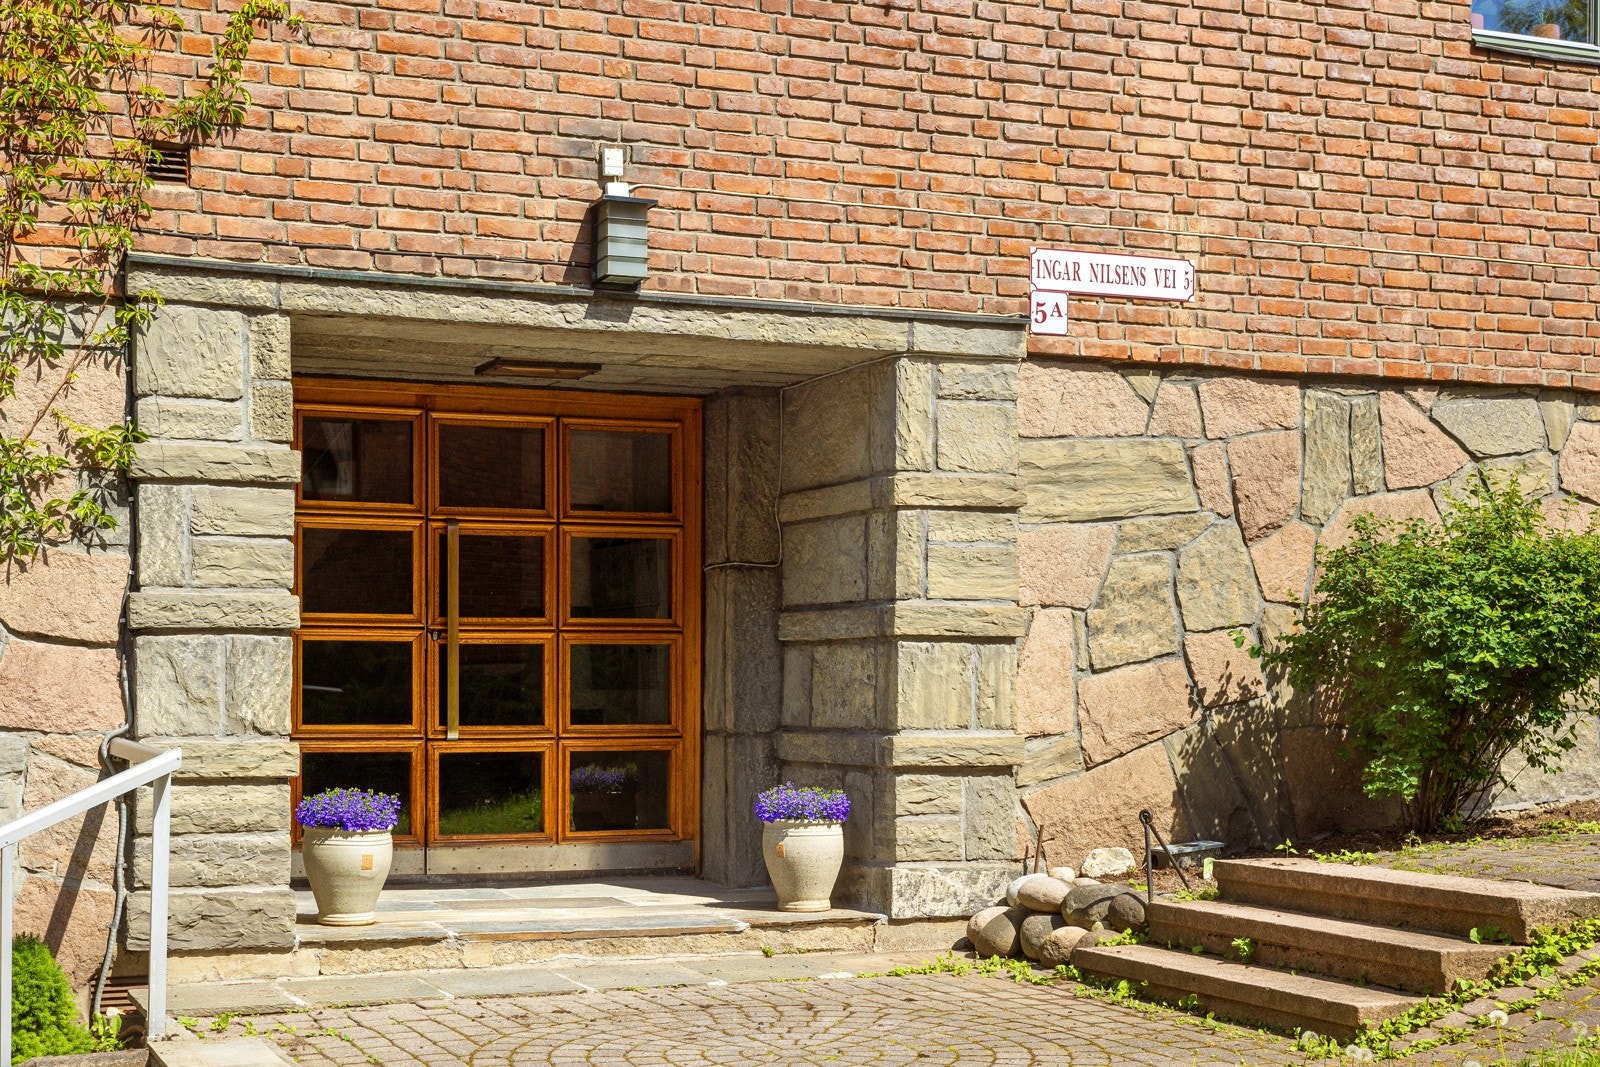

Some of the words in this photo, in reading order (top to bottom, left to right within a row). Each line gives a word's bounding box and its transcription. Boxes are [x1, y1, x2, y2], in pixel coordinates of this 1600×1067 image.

[1036, 259, 1081, 282] INGAR
[1089, 263, 1146, 286] NILSENS
[1154, 268, 1176, 289] VEI
[1183, 270, 1190, 290] 5
[1034, 301, 1063, 323] 5A
